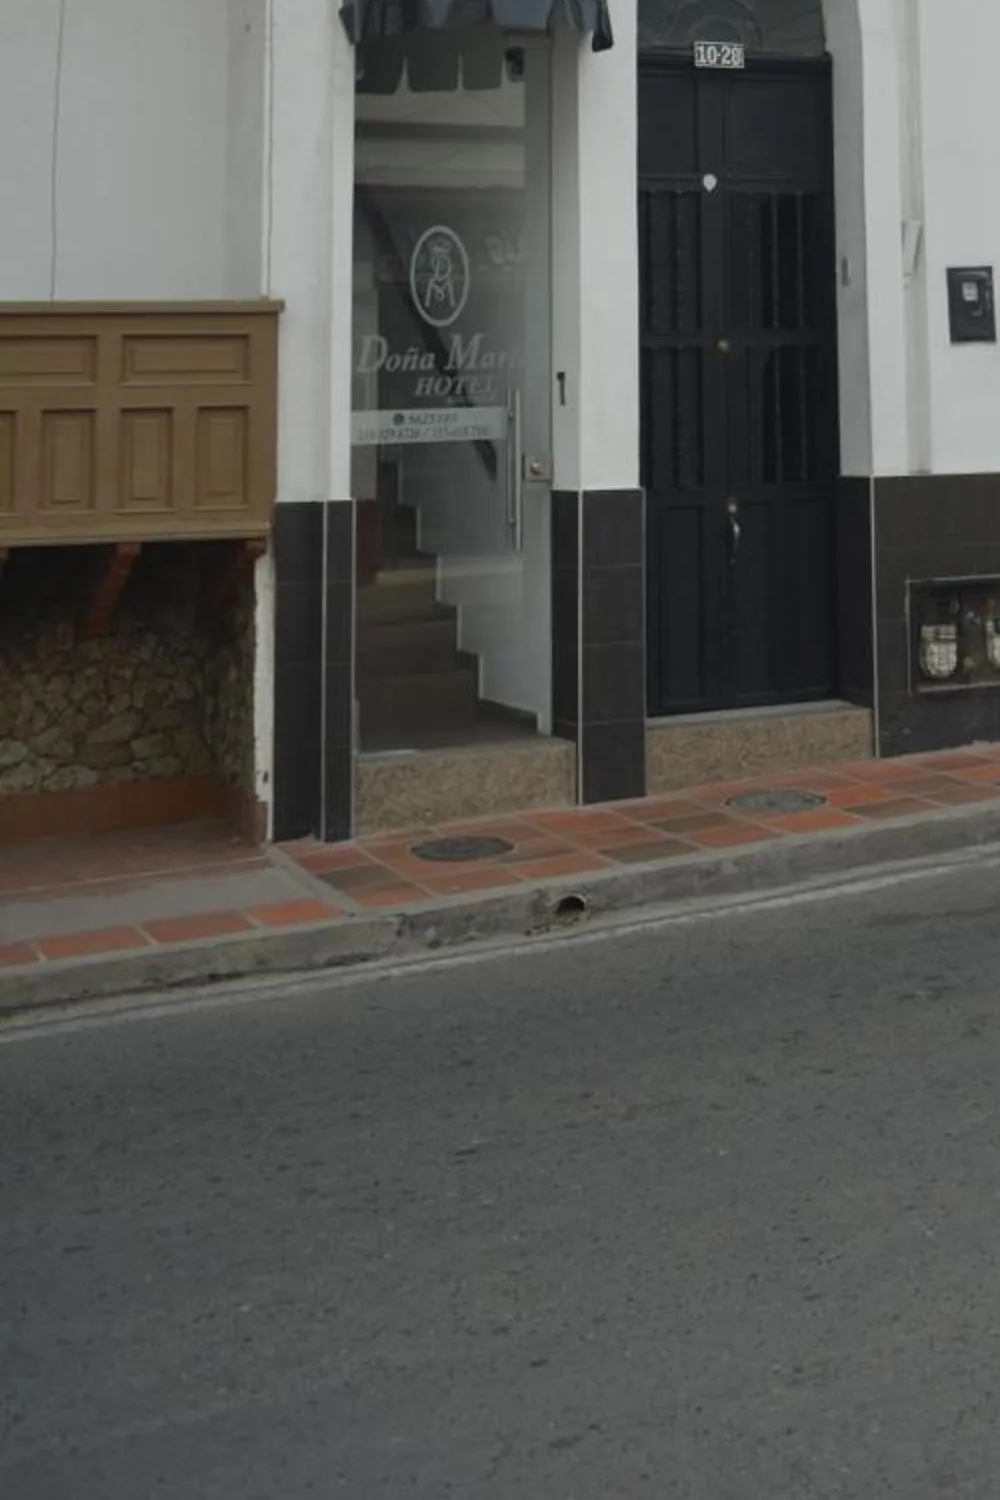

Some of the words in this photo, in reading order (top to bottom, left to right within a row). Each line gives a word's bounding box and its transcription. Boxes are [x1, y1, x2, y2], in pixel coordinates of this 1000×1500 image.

[356, 333, 437, 374] Doña
[443, 332, 526, 372] Mar
[413, 374, 499, 398] HOTEL
